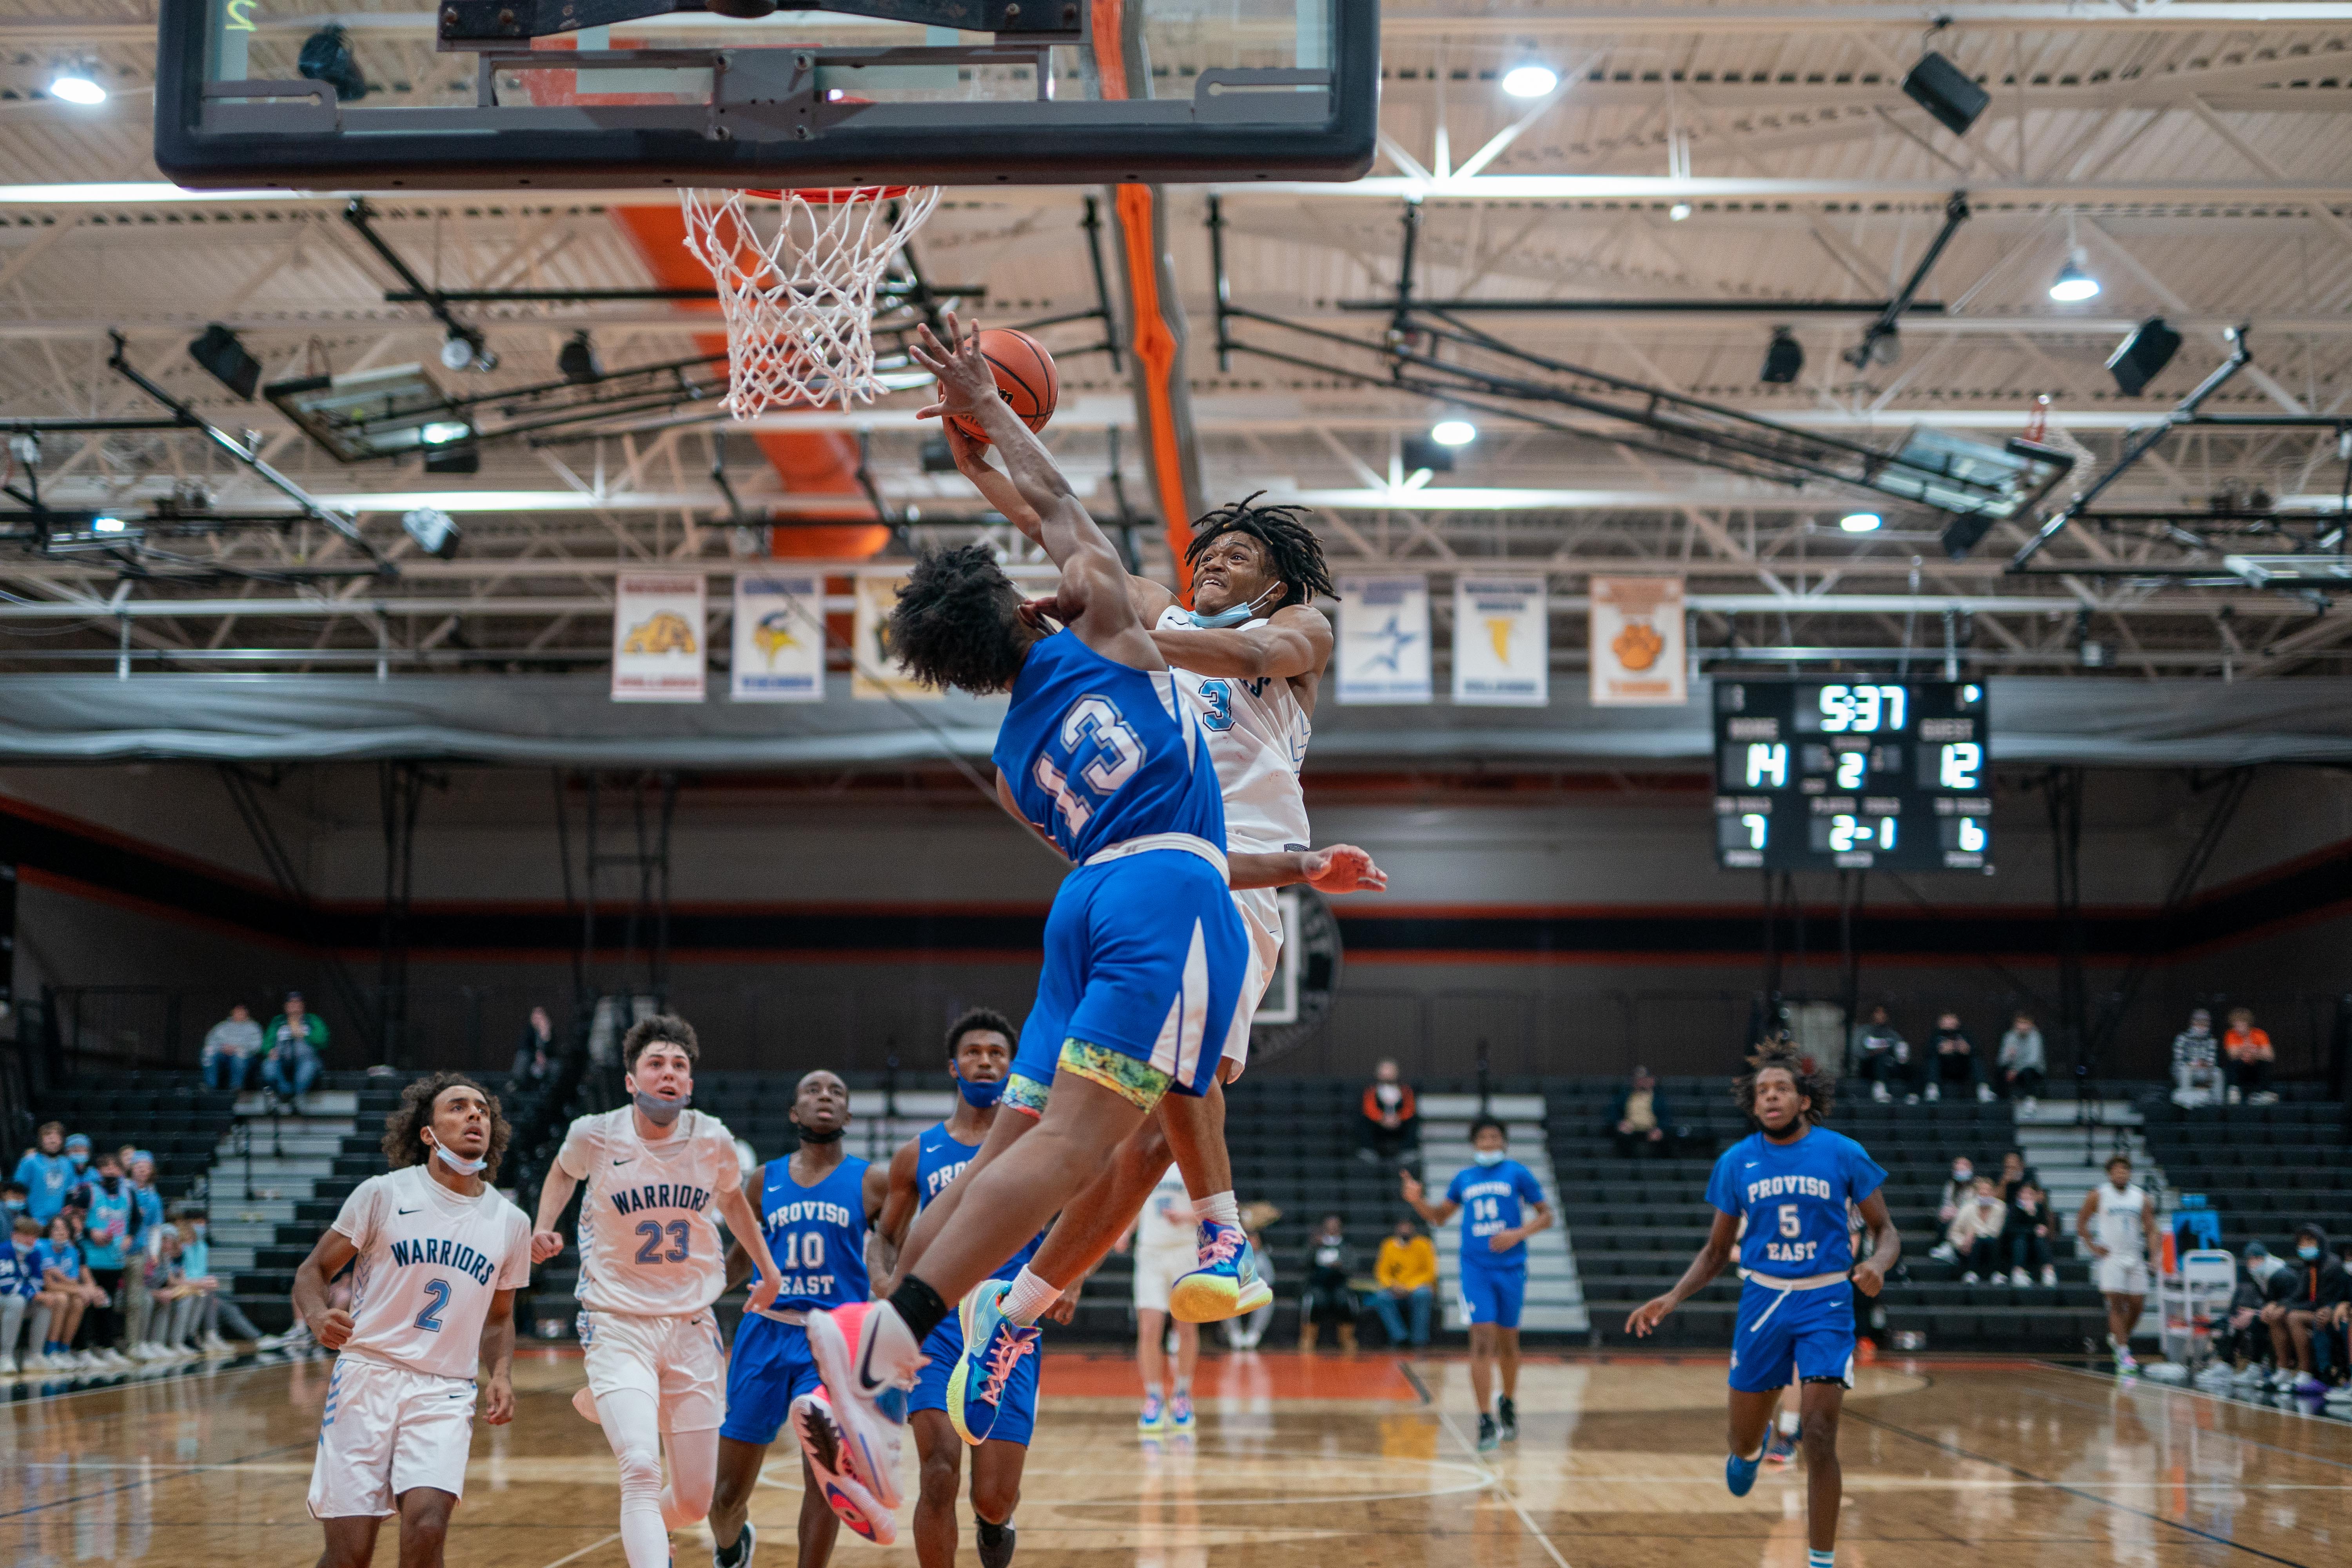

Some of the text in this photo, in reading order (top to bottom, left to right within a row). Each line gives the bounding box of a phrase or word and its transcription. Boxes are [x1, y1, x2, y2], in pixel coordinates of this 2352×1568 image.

[1198, 679, 1235, 731] 3
[1819, 684, 1908, 732] 5:37
[1032, 693, 1148, 839] 13
[1746, 743, 1789, 787] 14
[1837, 751, 1867, 789] 2
[1940, 742, 1983, 789] 12
[1741, 813, 1768, 850] 7
[1958, 817, 1988, 852] 6
[927, 1161, 972, 1196] PRO
[1747, 1175, 1831, 1203] PROVISO
[768, 1201, 850, 1234] PROVISO
[1473, 1197, 1499, 1221] 14
[1778, 1203, 1801, 1238] 5
[635, 1219, 690, 1265] 23
[785, 1231, 825, 1270] 10
[1766, 1241, 1818, 1261] EAST
[390, 1238, 495, 1287] WARRIORS
[779, 1275, 835, 1295] EAST
[414, 1278, 452, 1333] 2
